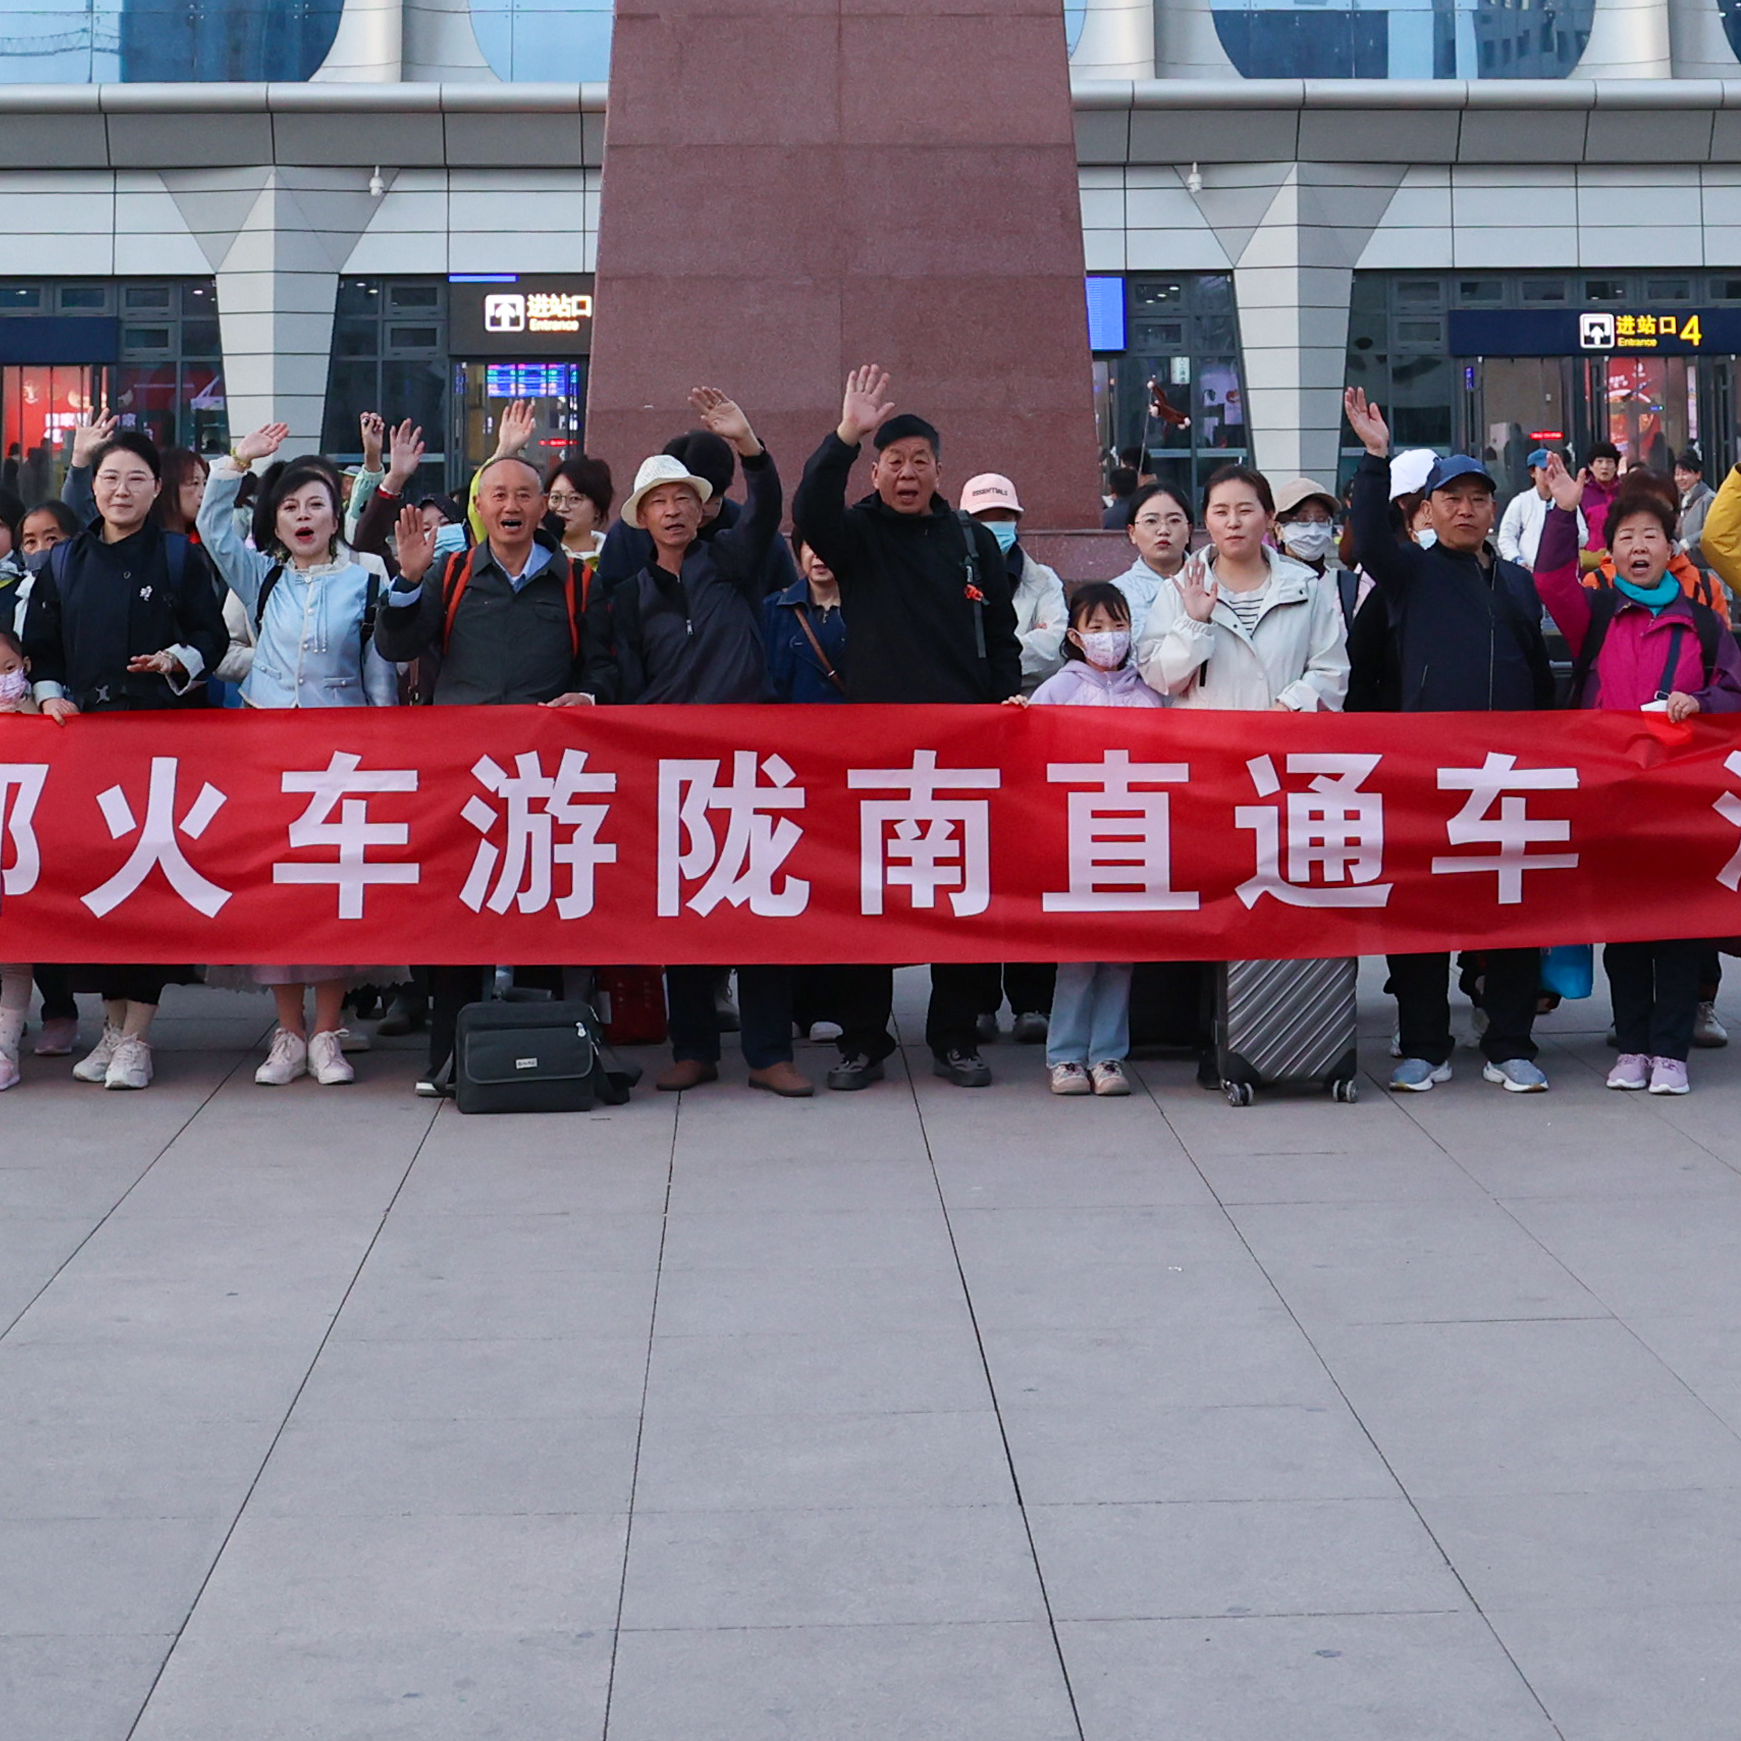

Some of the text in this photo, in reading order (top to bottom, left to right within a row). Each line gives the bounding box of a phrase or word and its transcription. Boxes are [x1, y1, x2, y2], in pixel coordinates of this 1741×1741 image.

[527, 292, 592, 318] 进站口
[528, 318, 580, 332] Entrance
[1616, 314, 1702, 347] 进站口 4
[1617, 337, 1658, 348] Entrance
